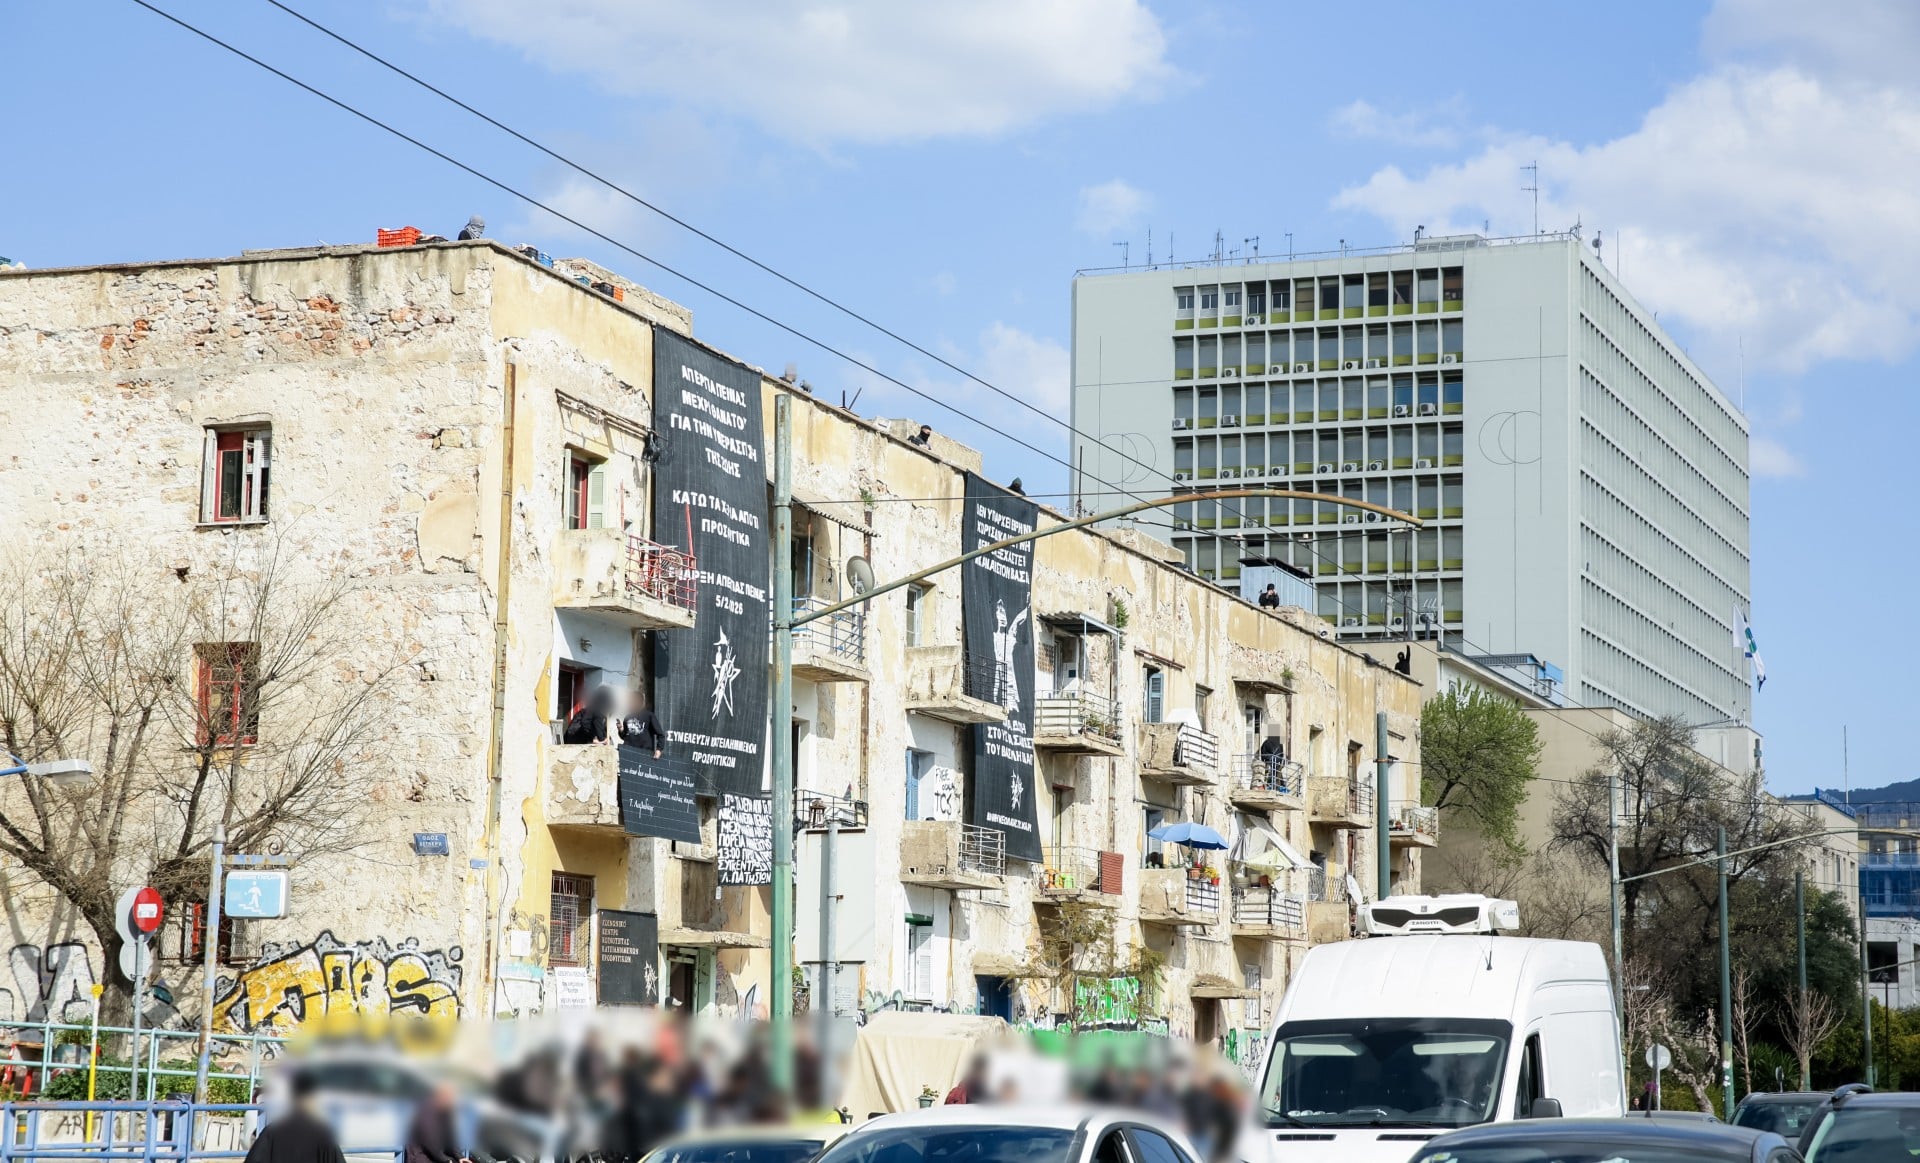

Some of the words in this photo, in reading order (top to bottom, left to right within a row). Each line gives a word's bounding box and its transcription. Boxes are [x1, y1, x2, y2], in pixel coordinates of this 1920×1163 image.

[670, 413, 692, 432] ΓΙΑ
[693, 418, 713, 439] ΤΗΝ
[672, 489, 707, 508] ΚΑΤΩ
[709, 495, 721, 511] ΤΑ
[667, 730, 710, 746] ΣΥΝΕΛΕΥΣΗ
[985, 742, 1000, 756] ΤΟΥ
[718, 847, 740, 860] 13:00
